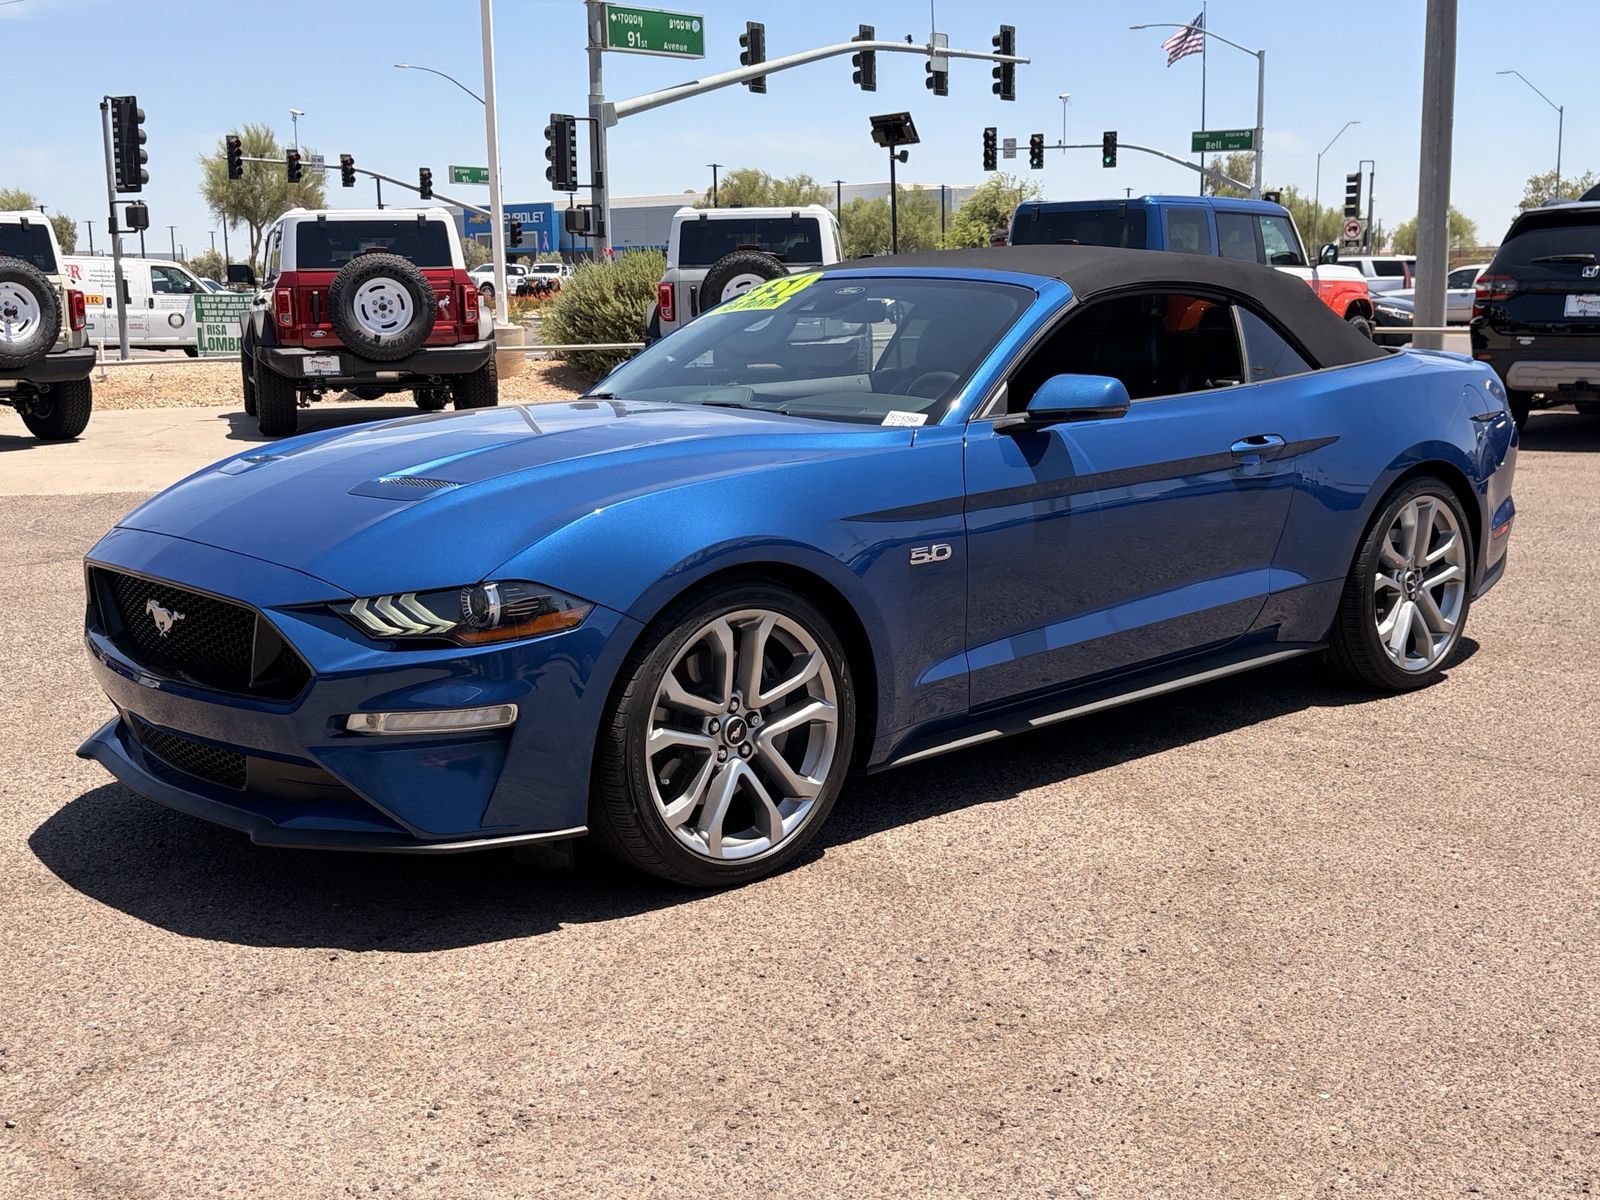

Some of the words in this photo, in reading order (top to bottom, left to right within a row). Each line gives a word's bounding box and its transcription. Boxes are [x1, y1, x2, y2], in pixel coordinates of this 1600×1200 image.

[663, 41, 688, 52] Avenue
[1205, 141, 1222, 150] Bell
[504, 211, 545, 225] EVROLET
[206, 324, 227, 336] RISA
[910, 543, 952, 565] 5.0
